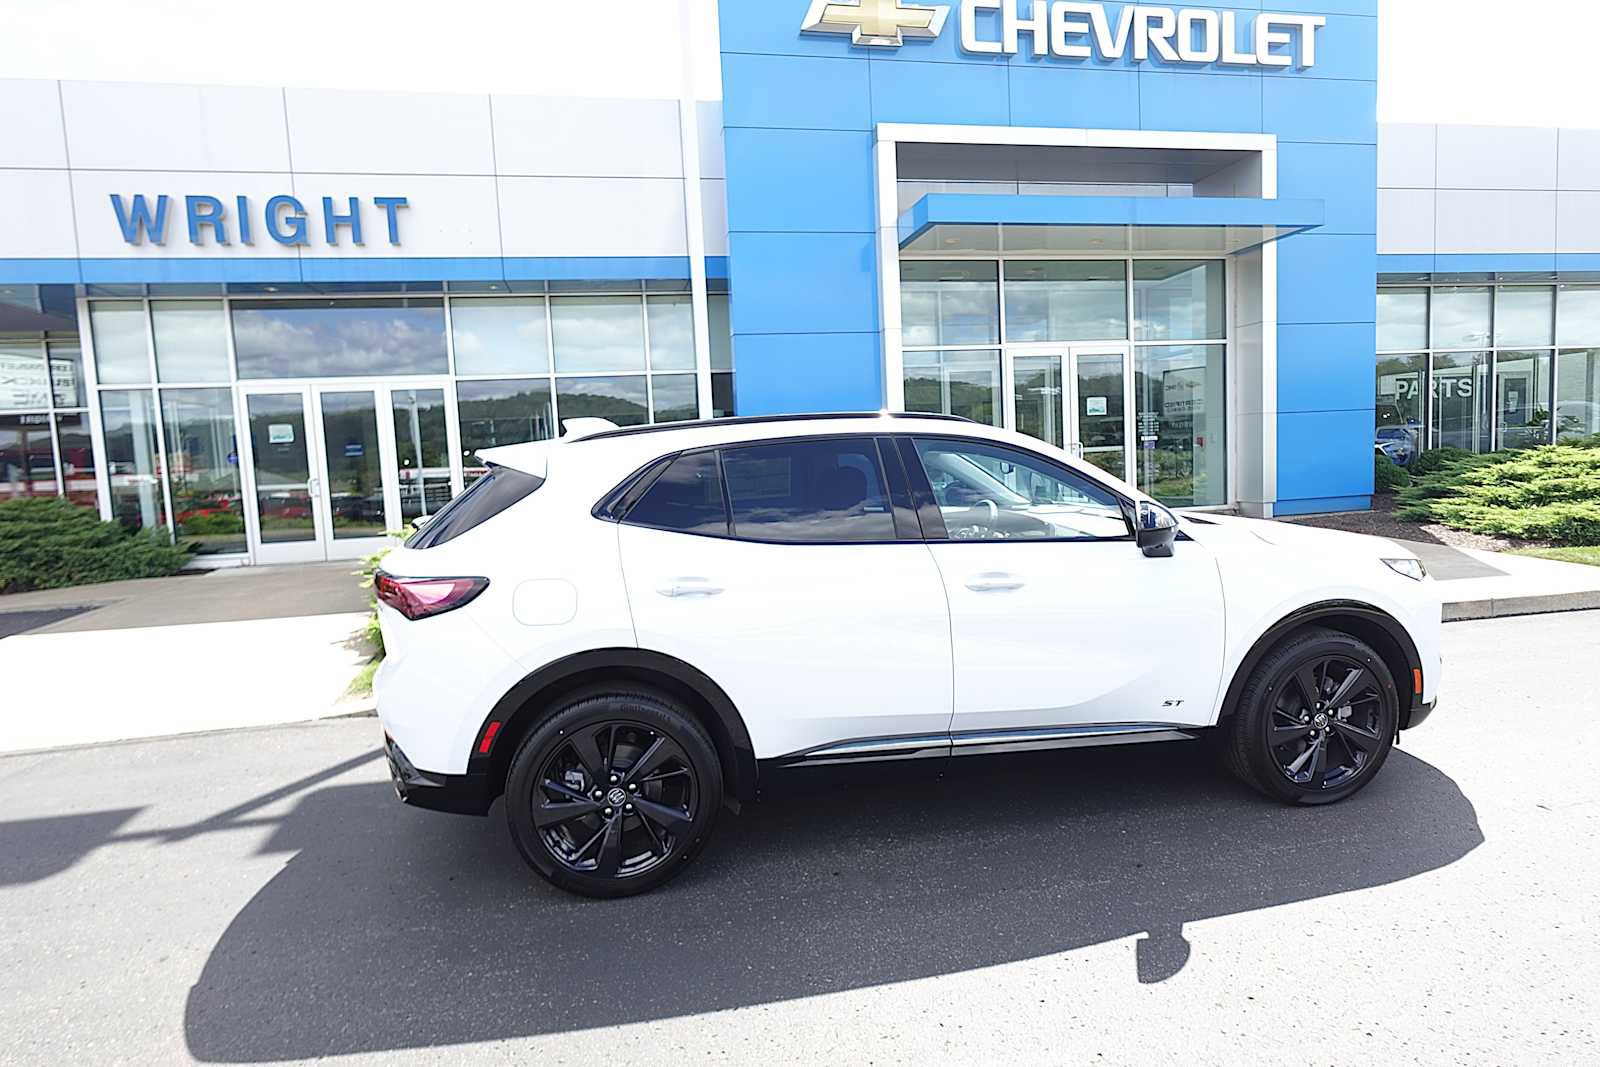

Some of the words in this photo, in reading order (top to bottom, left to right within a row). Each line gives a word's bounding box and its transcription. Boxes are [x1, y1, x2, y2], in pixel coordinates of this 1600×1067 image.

[961, 0, 1326, 68] CHEVROLET
[109, 193, 409, 247] WRIGHT
[1161, 699, 1185, 707] ST
